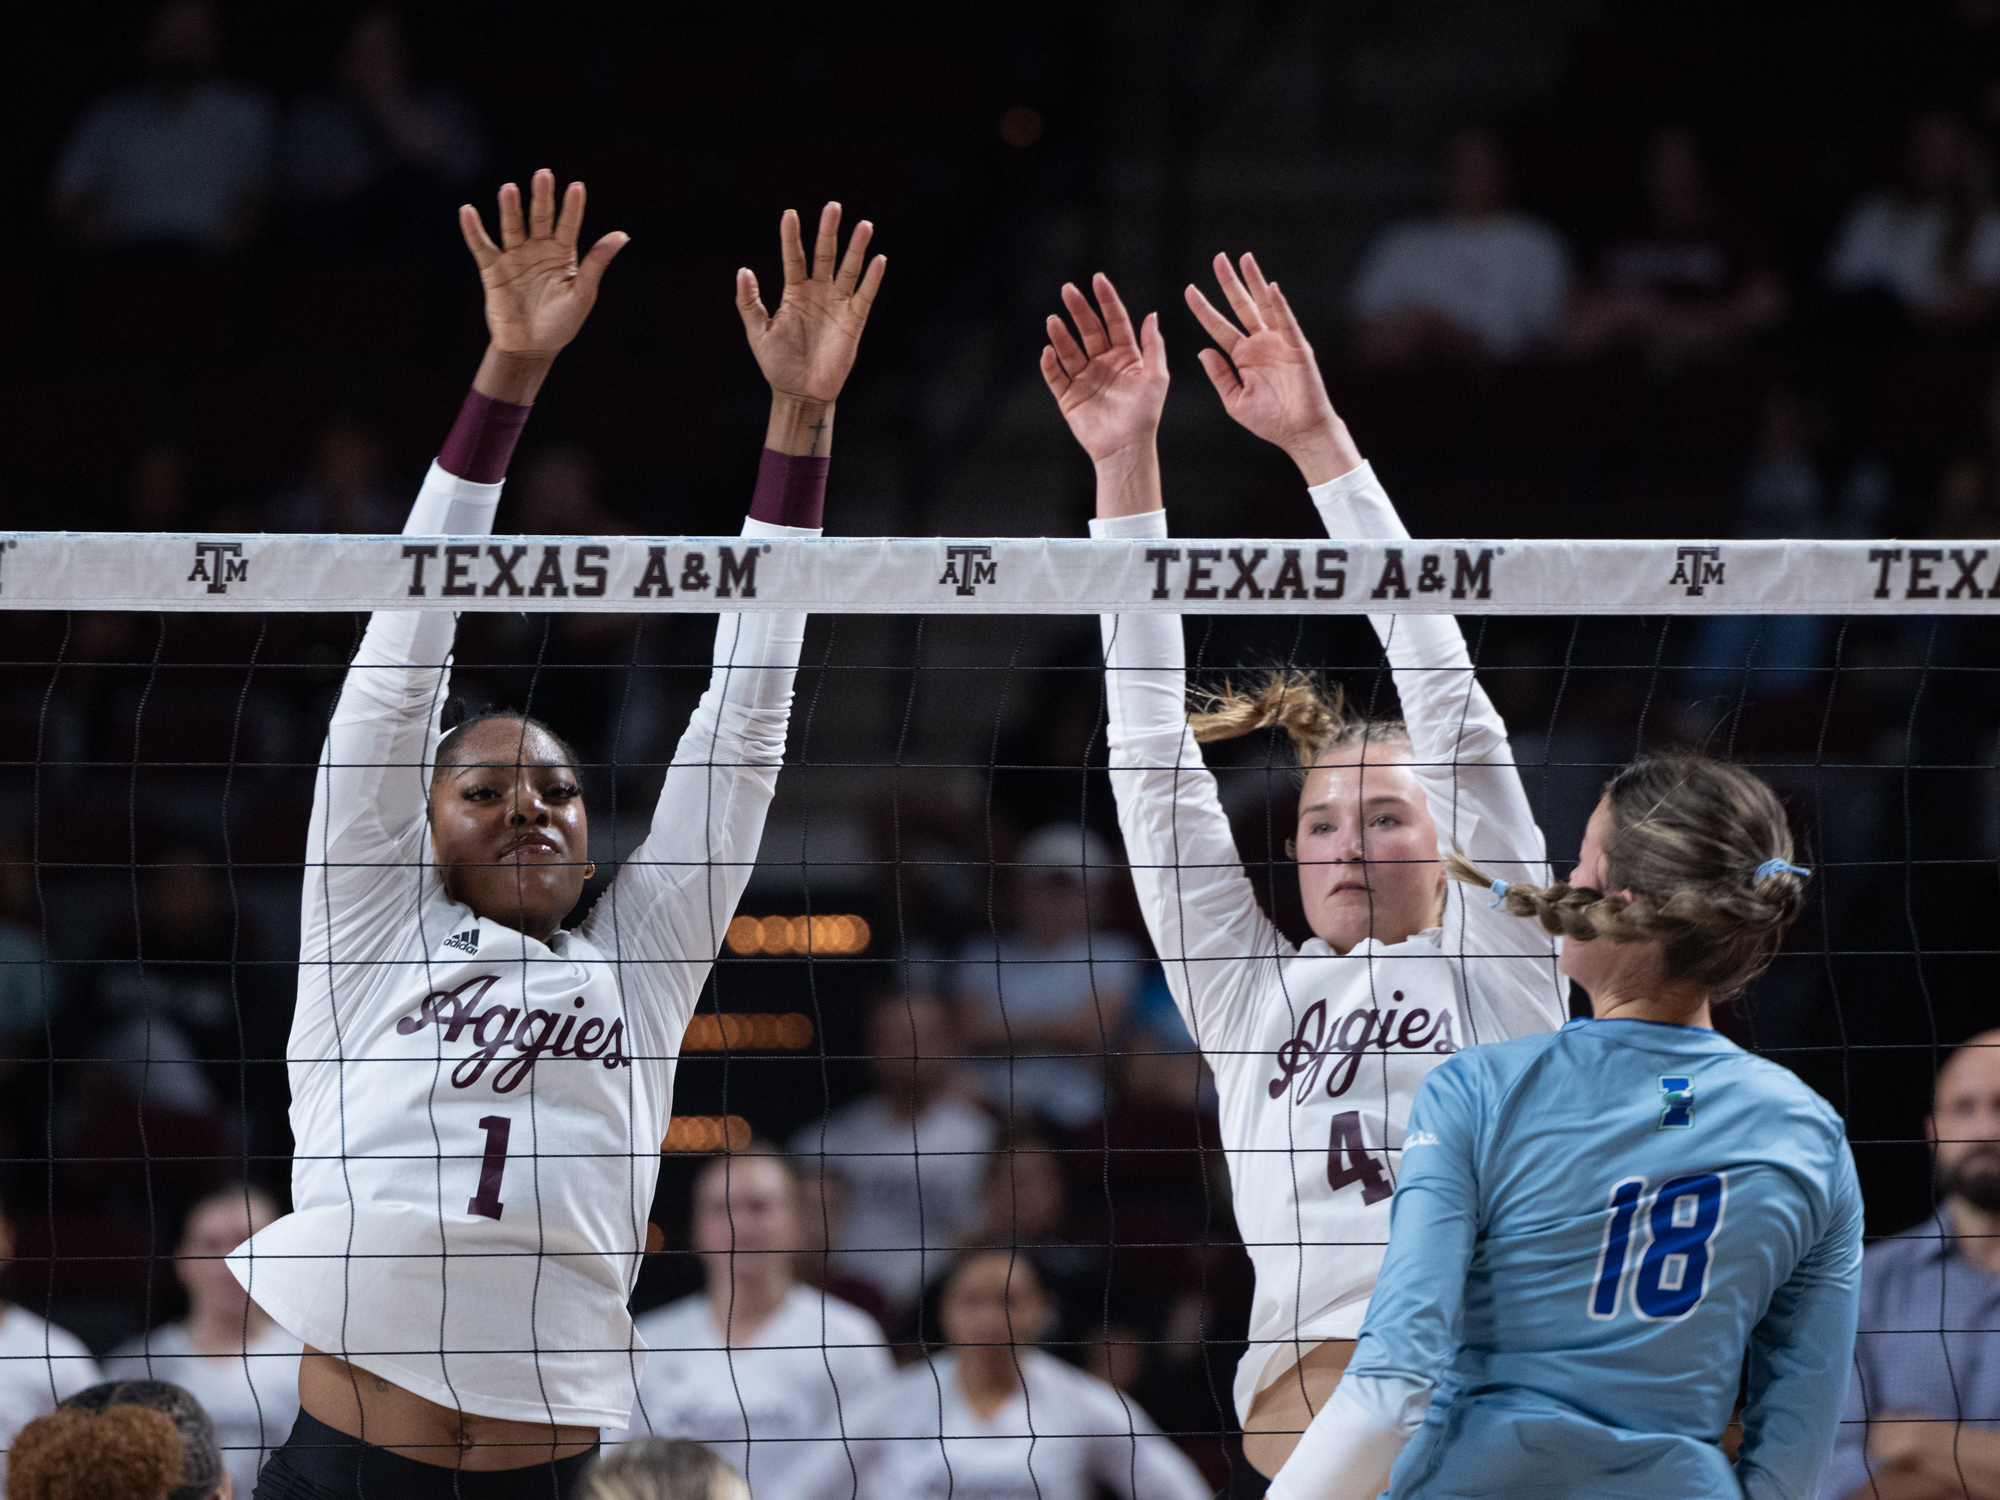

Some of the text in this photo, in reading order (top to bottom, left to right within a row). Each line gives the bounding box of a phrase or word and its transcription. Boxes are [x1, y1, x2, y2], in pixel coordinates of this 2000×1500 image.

[402, 545, 761, 598] TEXAS A&M
[1145, 548, 1494, 599] TEXAS A&M
[396, 975, 631, 1094] Aggies
[468, 1116, 511, 1220] 1
[1327, 1110, 1394, 1206] 4
[1587, 1172, 1728, 1322] 18
